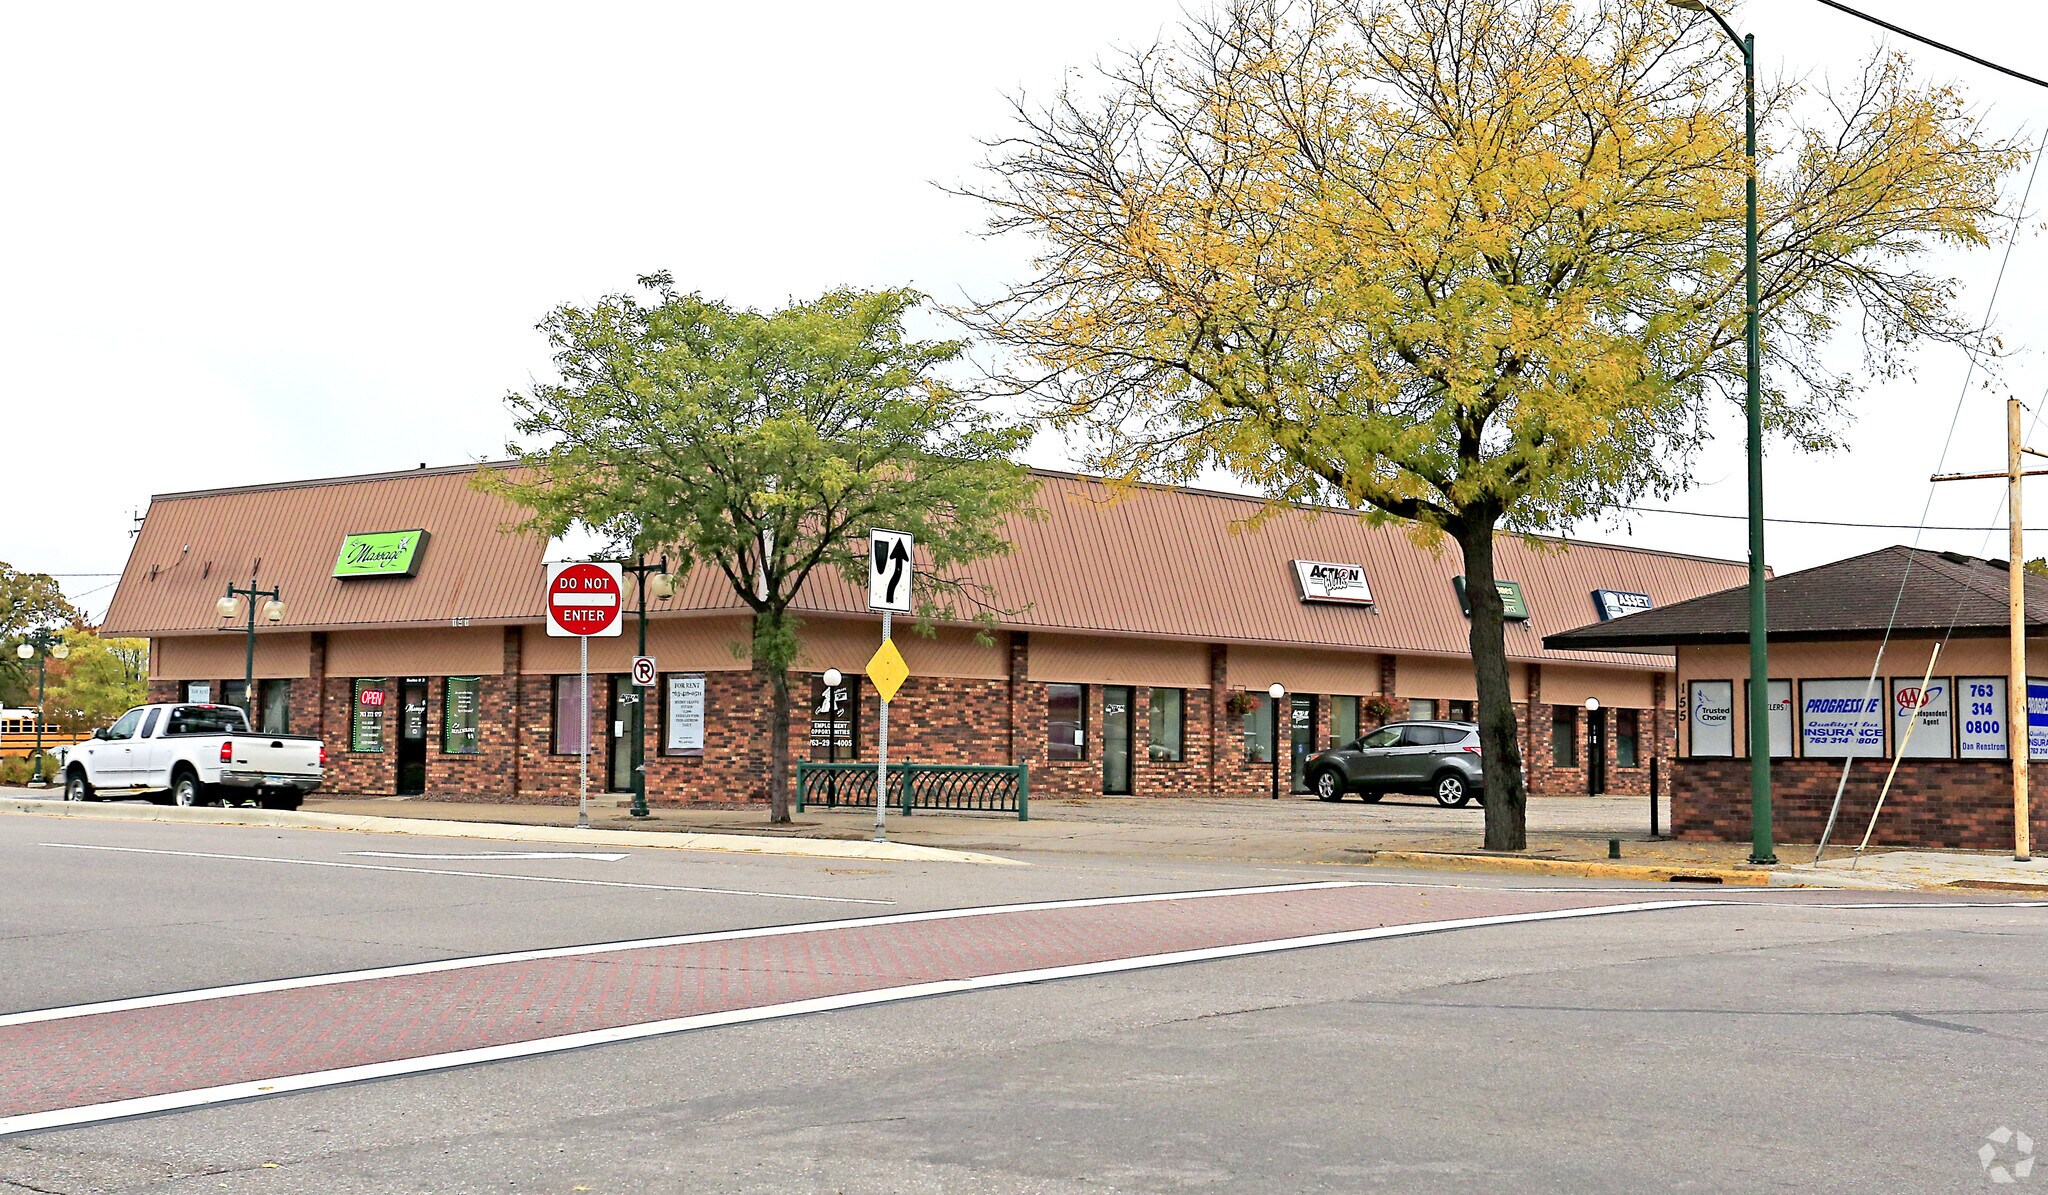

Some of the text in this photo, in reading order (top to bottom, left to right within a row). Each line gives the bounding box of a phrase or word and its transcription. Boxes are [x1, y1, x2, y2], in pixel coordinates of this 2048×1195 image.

[346, 543, 402, 568] Massage
[560, 578, 609, 589] DO NOT
[1619, 593, 1649, 607] ASSET
[563, 610, 604, 621] ENTER
[1970, 684, 1994, 697] 763
[361, 690, 383, 705] OPEN
[1971, 702, 1993, 716] 314
[1966, 721, 1999, 734] 0800
